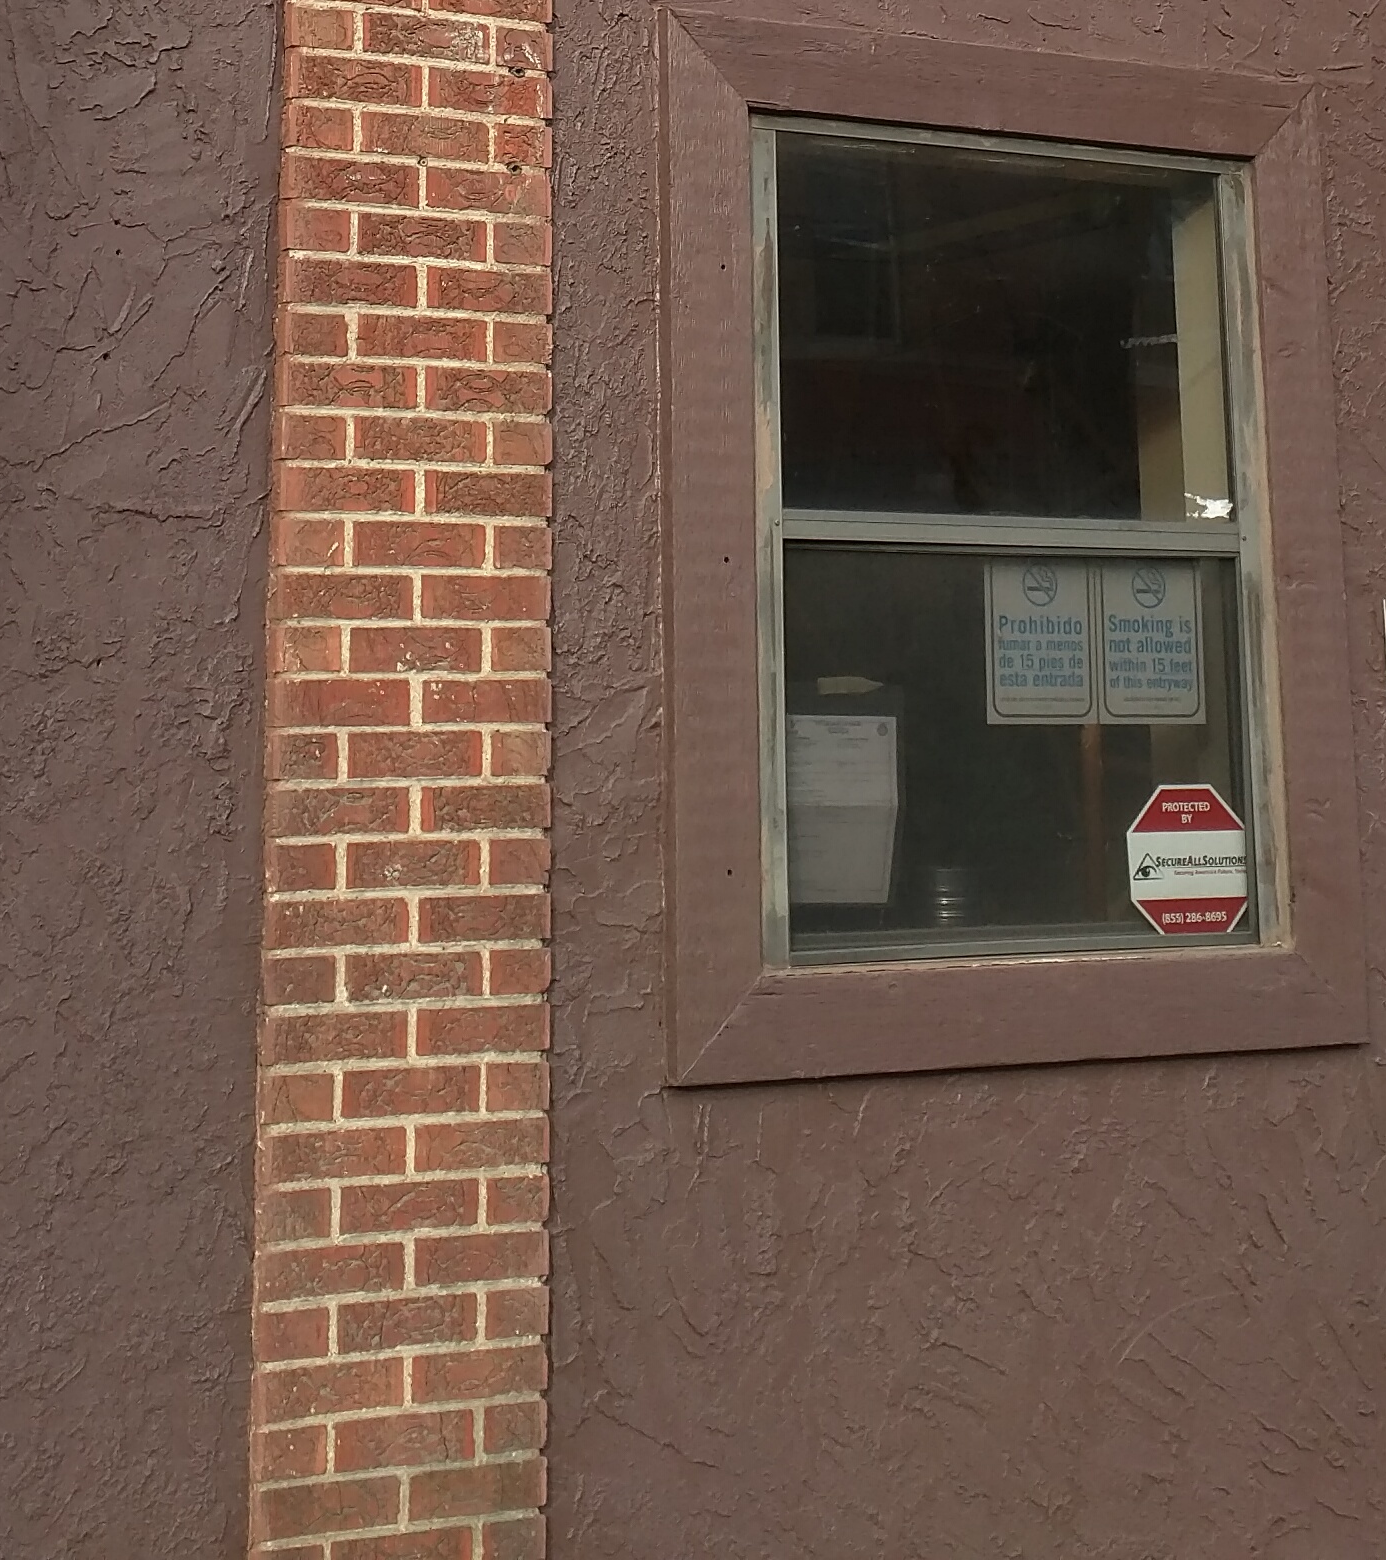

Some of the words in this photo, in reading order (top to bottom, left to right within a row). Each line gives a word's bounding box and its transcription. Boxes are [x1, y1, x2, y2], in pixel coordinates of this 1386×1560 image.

[998, 614, 1083, 636] Prohibido
[1108, 614, 1173, 637] Smoking
[1179, 615, 1193, 634] is
[998, 638, 1031, 651] fumar
[1035, 639, 1042, 651] a
[1046, 638, 1084, 652] menos
[1108, 639, 1132, 653] not
[1137, 637, 1192, 654] allowed
[999, 655, 1014, 669] de
[1020, 653, 1034, 669] 15
[1038, 654, 1065, 672] pies
[1069, 655, 1084, 670] de
[1109, 658, 1147, 673] within
[1152, 657, 1166, 673] 15
[1169, 658, 1193, 674] feet
[999, 672, 1028, 687] esta
[1033, 671, 1084, 687] entrada
[1109, 675, 1120, 687] of
[1123, 675, 1143, 689] this
[1147, 676, 1193, 692] entryway
[1162, 802, 1210, 812] PROTECTED
[1181, 813, 1192, 824] BY
[1162, 912, 1184, 925] (855)
[1185, 911, 1228, 922] 286-8695
